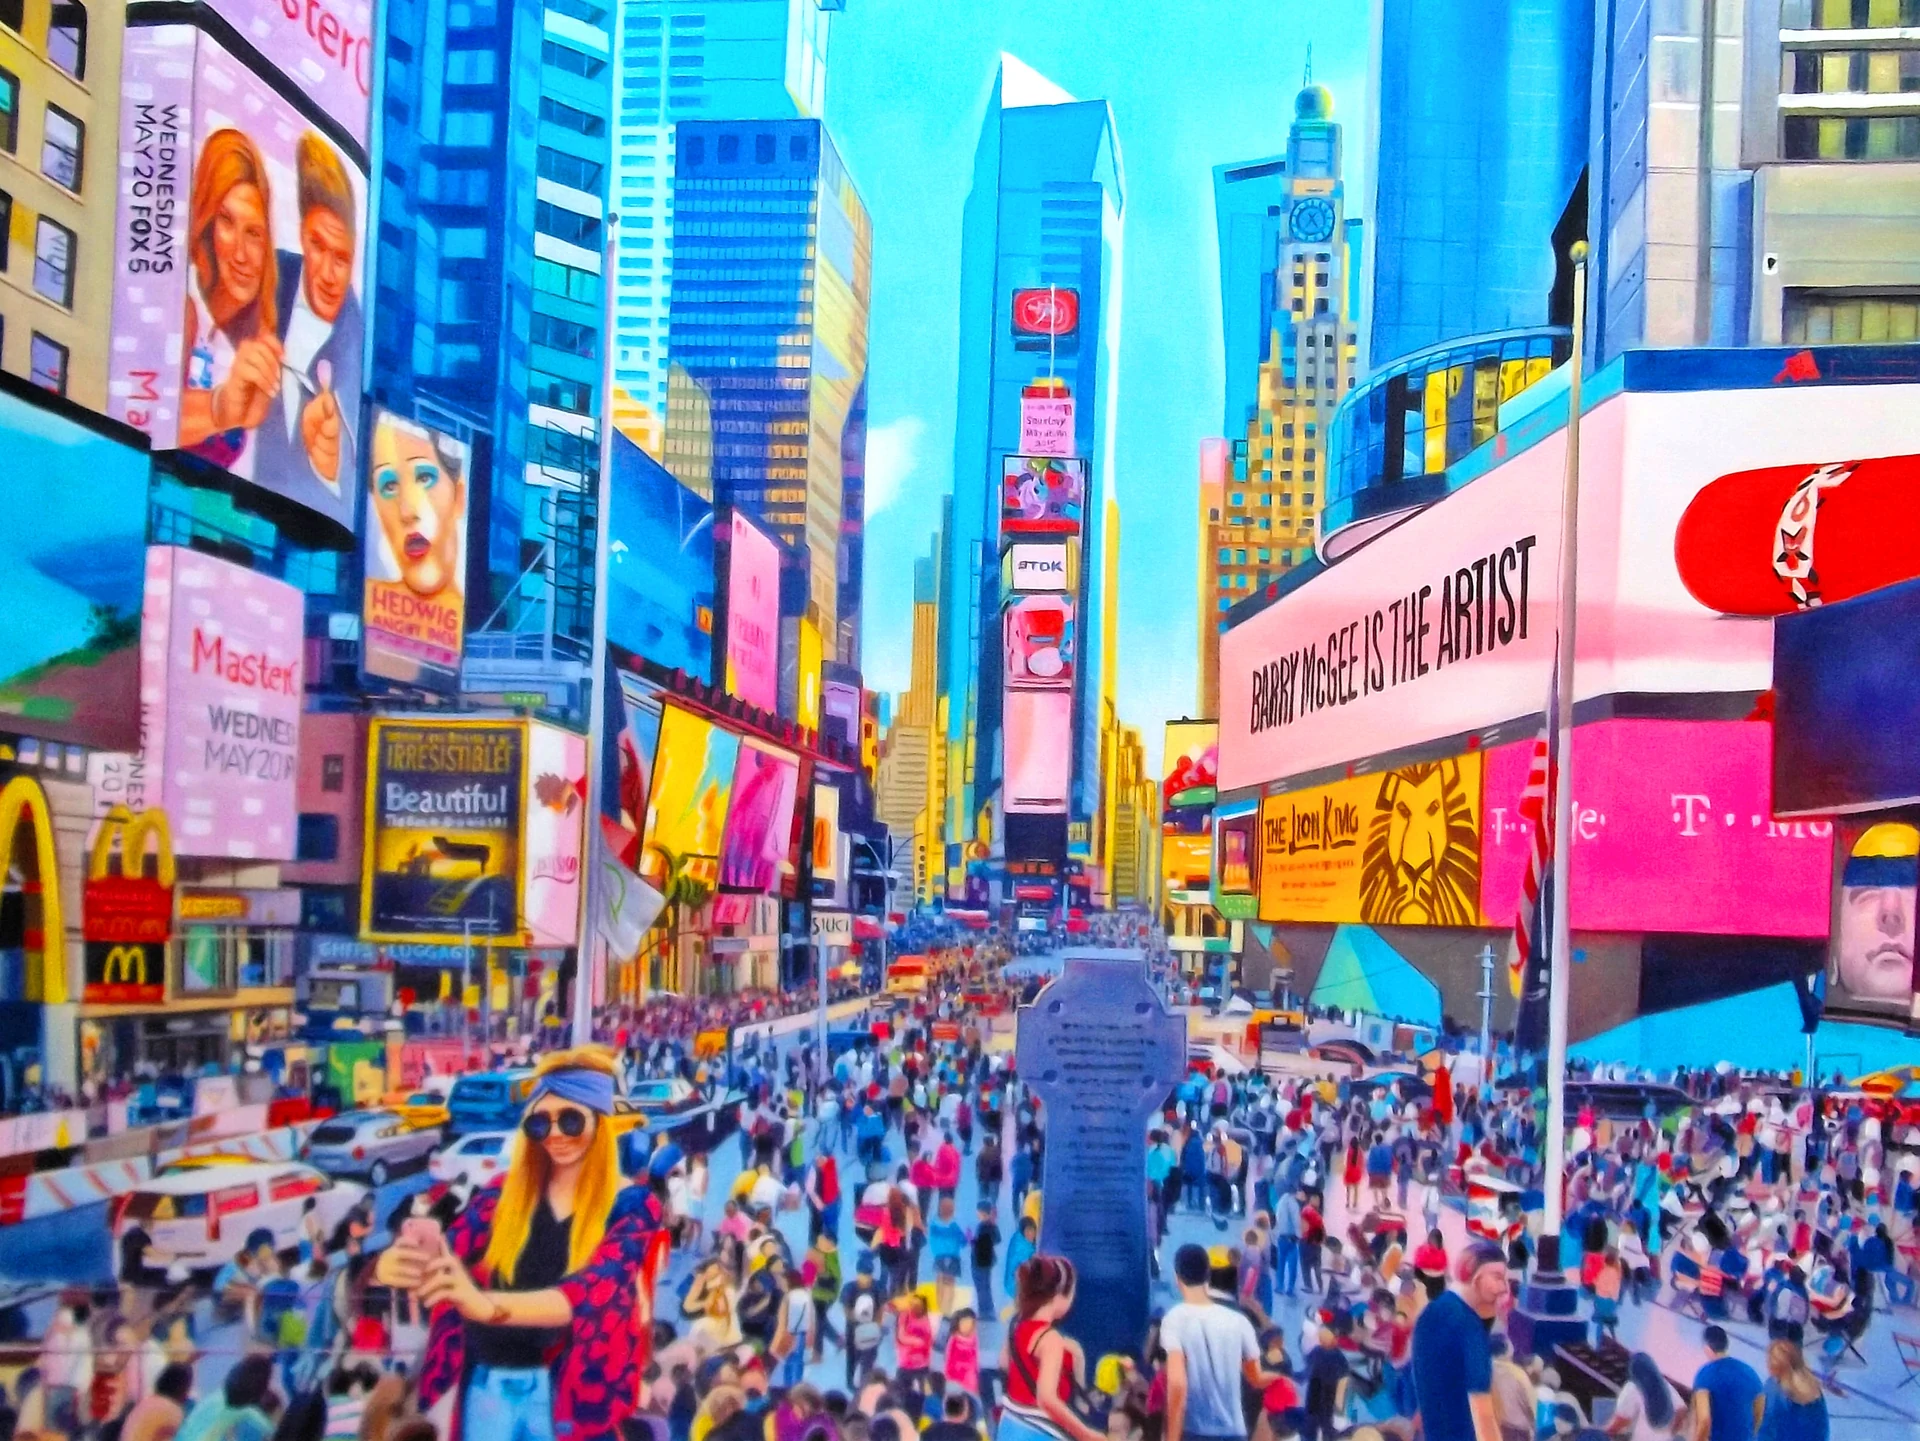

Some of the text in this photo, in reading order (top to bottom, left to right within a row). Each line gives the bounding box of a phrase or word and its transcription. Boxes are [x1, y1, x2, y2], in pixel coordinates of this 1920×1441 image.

[128, 104, 157, 274] MAY 20 FOX 5
[151, 104, 178, 274] WEDNESDAYS
[372, 583, 458, 632] HEDWIG
[1250, 651, 1300, 735] BARRY
[1363, 609, 1384, 697] IS
[1388, 585, 1432, 687] THE
[1436, 534, 1537, 671] ARTIST
[204, 739, 257, 776] MAY
[386, 782, 508, 813] Beautiful
[1264, 816, 1288, 846] THE
